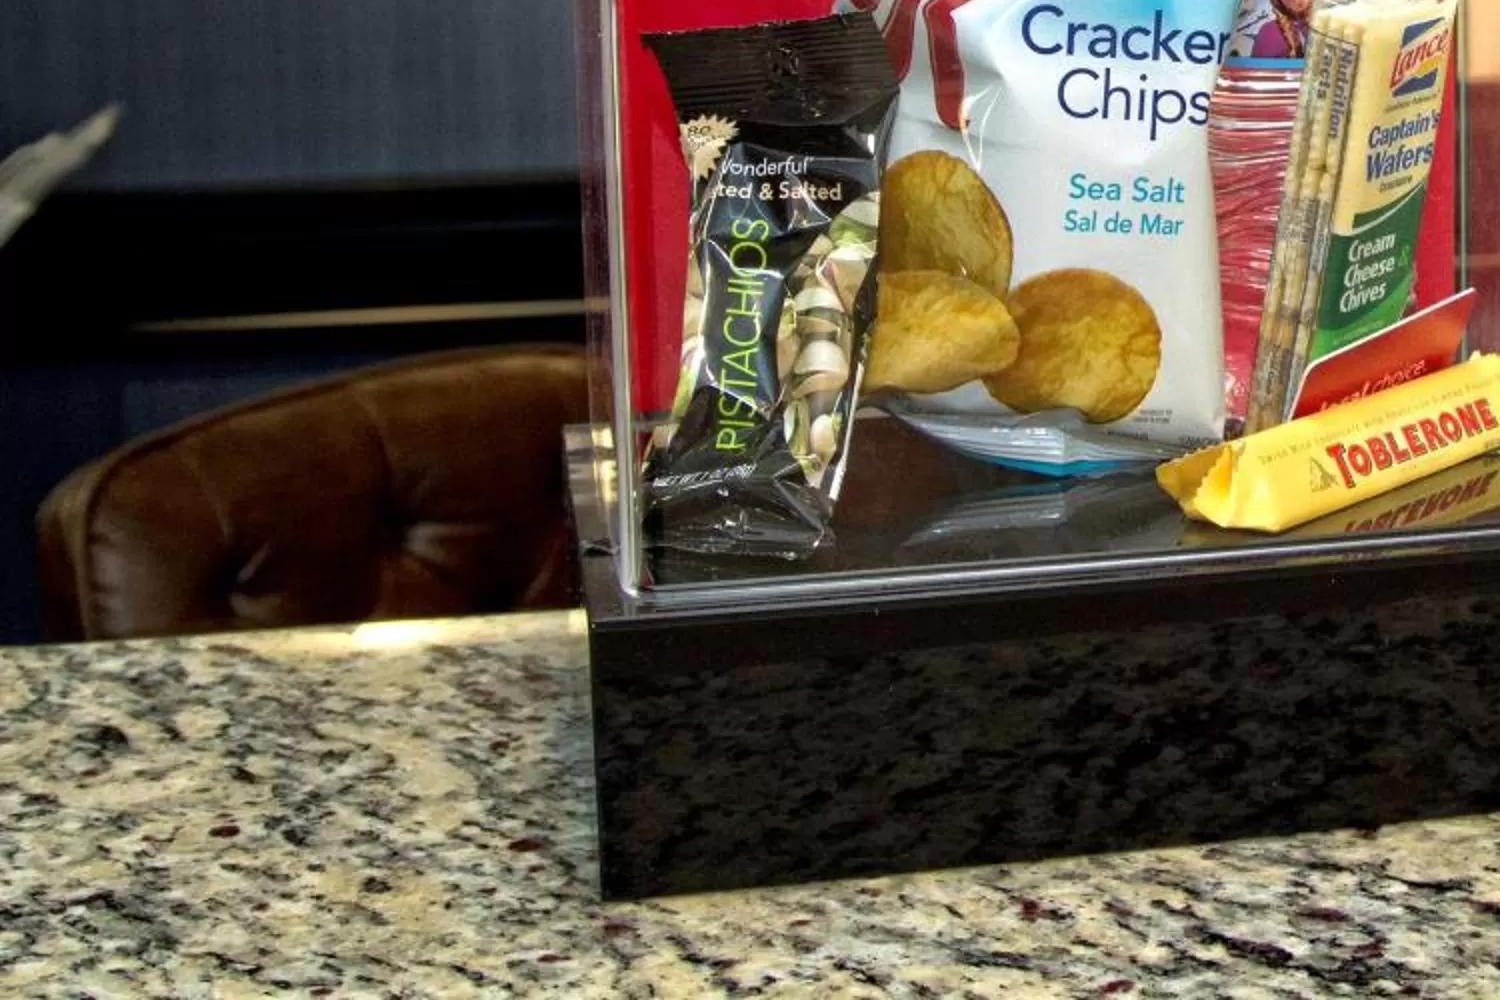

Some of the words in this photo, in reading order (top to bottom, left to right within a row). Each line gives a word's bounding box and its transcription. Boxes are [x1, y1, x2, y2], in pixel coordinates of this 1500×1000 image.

[1021, 3, 1231, 65] Cracker
[1315, 45, 1336, 101] Facts
[1390, 27, 1450, 90] Lance
[1057, 67, 1212, 141] Chips
[1328, 46, 1355, 139] Nutrition
[1367, 111, 1441, 150] Captain's
[1366, 142, 1433, 182] Wafers
[759, 182, 773, 200] &
[779, 181, 842, 201] Salted
[1069, 172, 1121, 201] Sea
[1131, 176, 1186, 204] Salt
[1064, 209, 1097, 232] Sal
[1104, 212, 1133, 233] de
[1139, 214, 1185, 236] Mar
[1348, 233, 1397, 262] Cream
[1343, 256, 1396, 288] Cheese
[1339, 281, 1388, 313] Chives
[715, 216, 770, 450] PISTACHIOS
[1326, 397, 1499, 489] TOBLERONE
